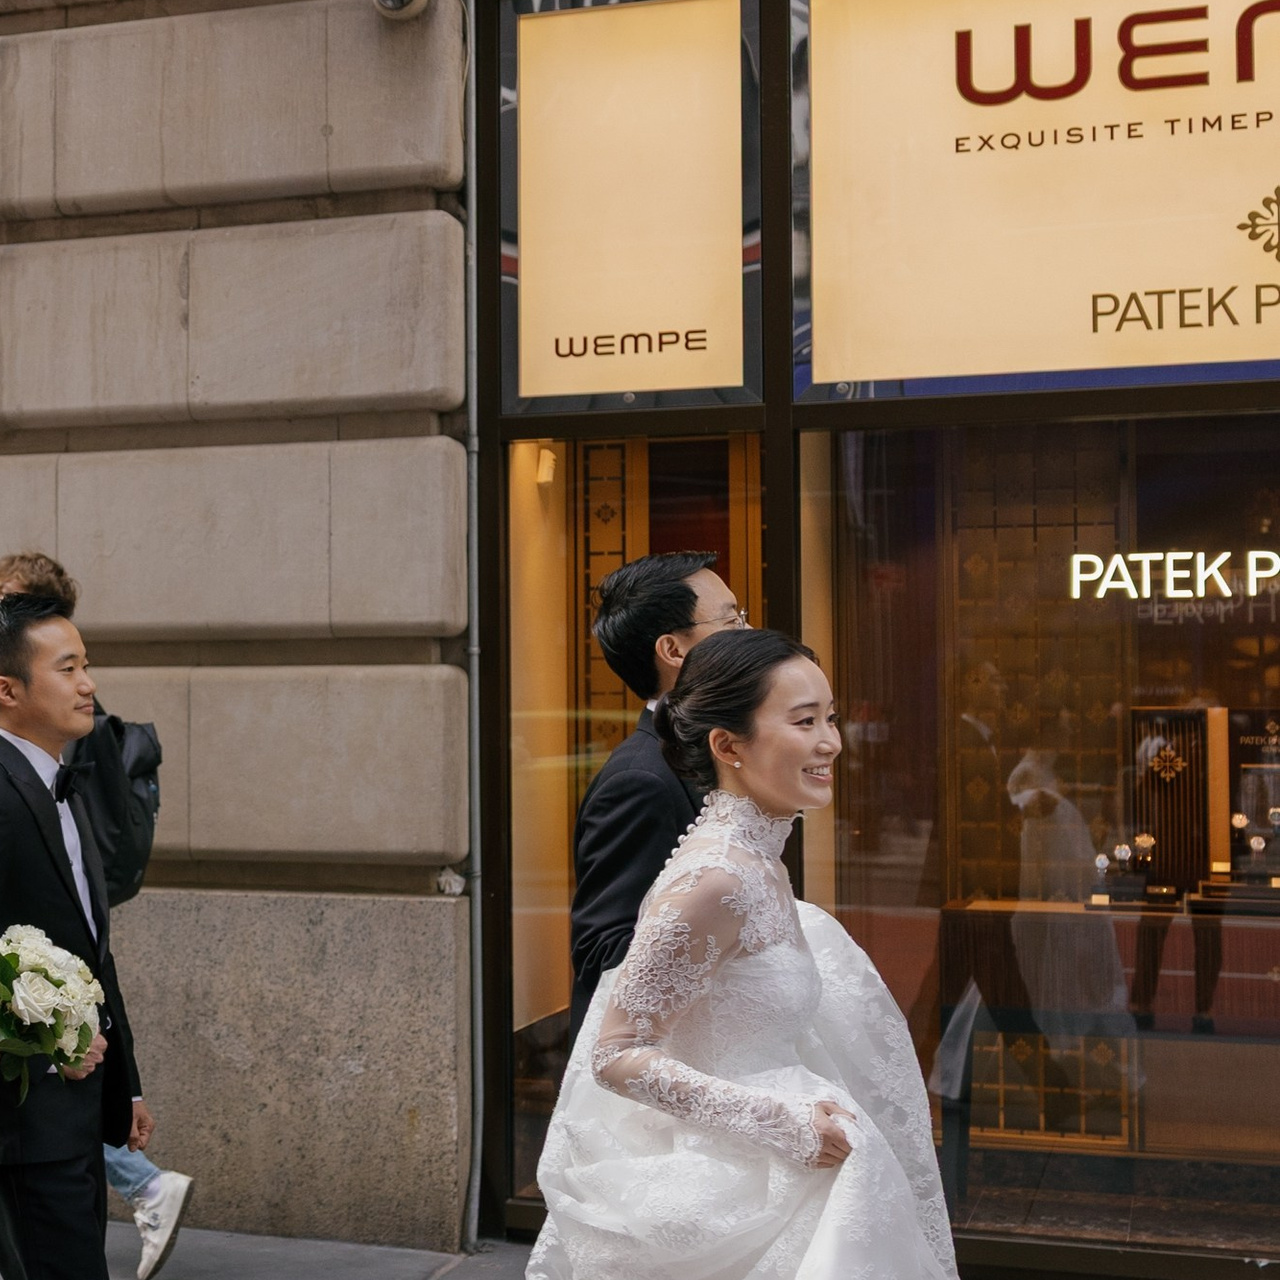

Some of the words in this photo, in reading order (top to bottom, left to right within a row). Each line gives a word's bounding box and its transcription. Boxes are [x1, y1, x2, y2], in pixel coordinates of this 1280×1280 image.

[955, 122, 1144, 153] EXQUISITE
[1164, 111, 1274, 136] TIMEP
[1092, 285, 1241, 333] PATEK
[1255, 284, 1280, 325] P
[555, 329, 707, 358] WEMPE
[1071, 551, 1233, 599] PATEK
[1247, 550, 1280, 598] P
